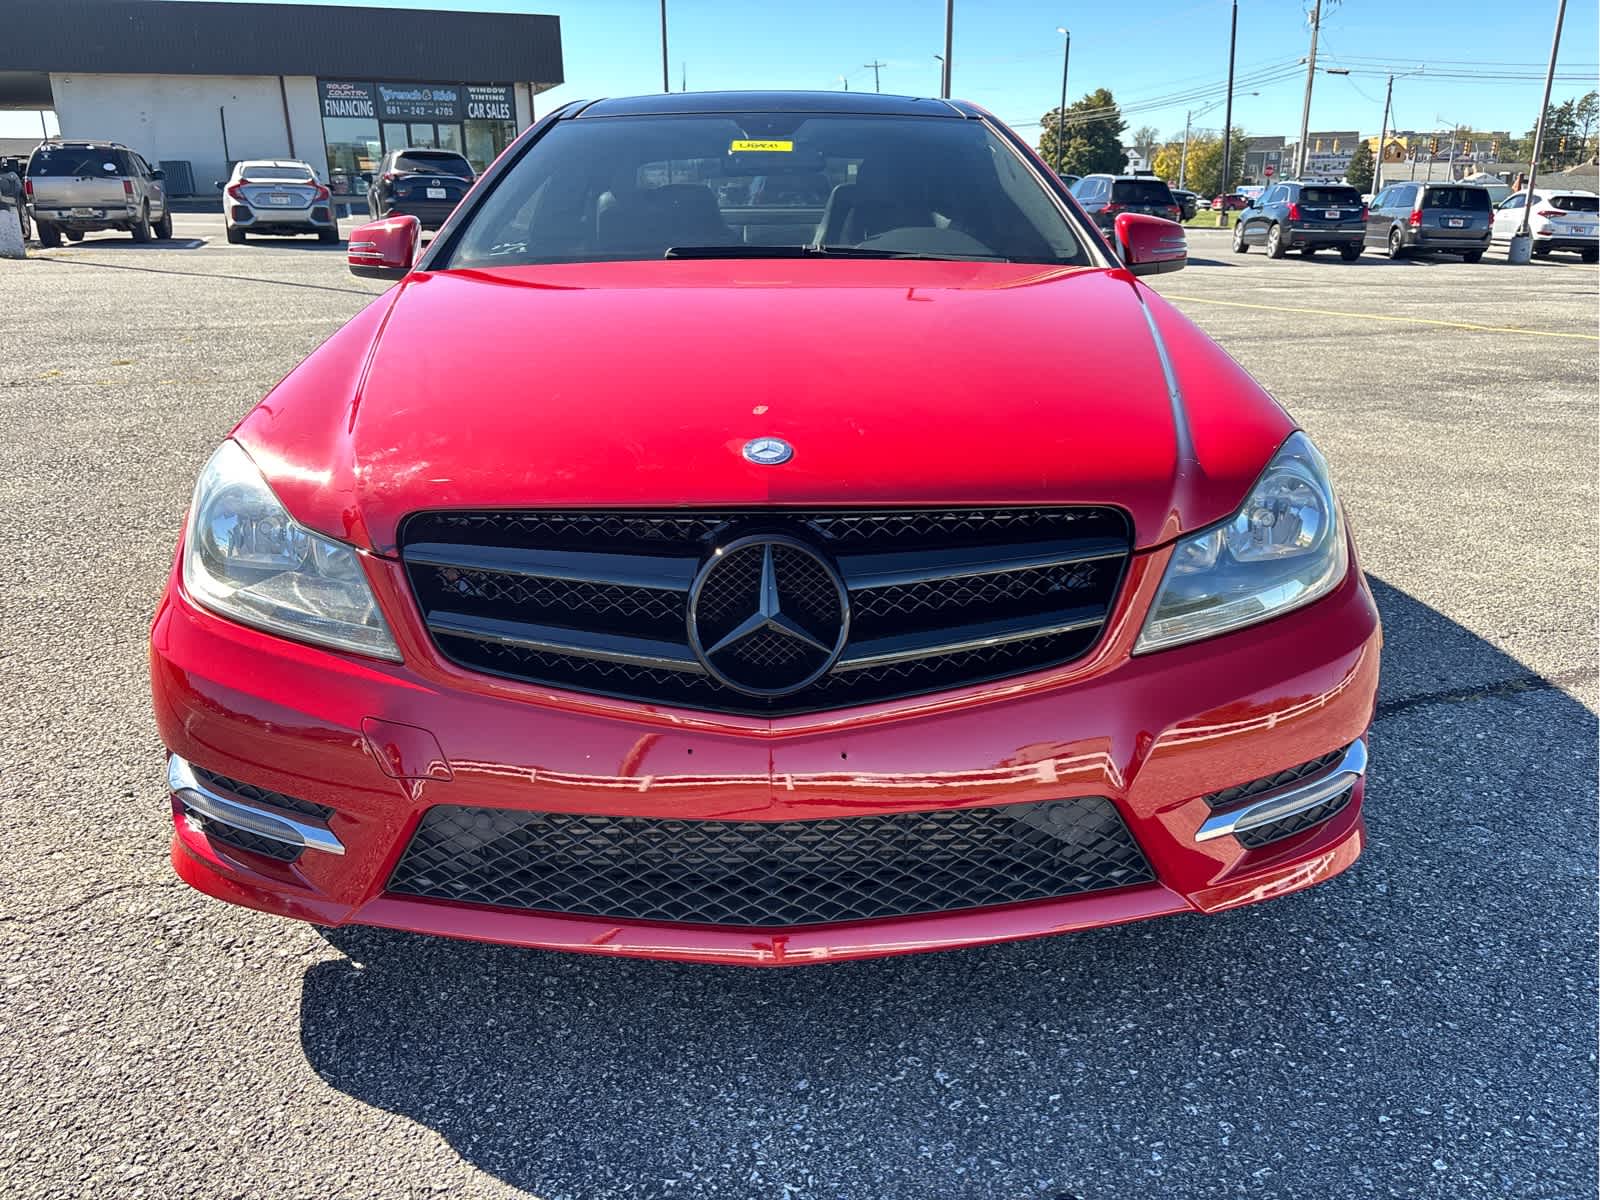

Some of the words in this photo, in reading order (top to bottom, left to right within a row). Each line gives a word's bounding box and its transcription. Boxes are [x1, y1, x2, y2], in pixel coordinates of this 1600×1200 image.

[328, 89, 367, 97] COUNTRY
[324, 99, 374, 117] FINANCING
[468, 102, 486, 119] CAR
[486, 103, 510, 119] SALES
